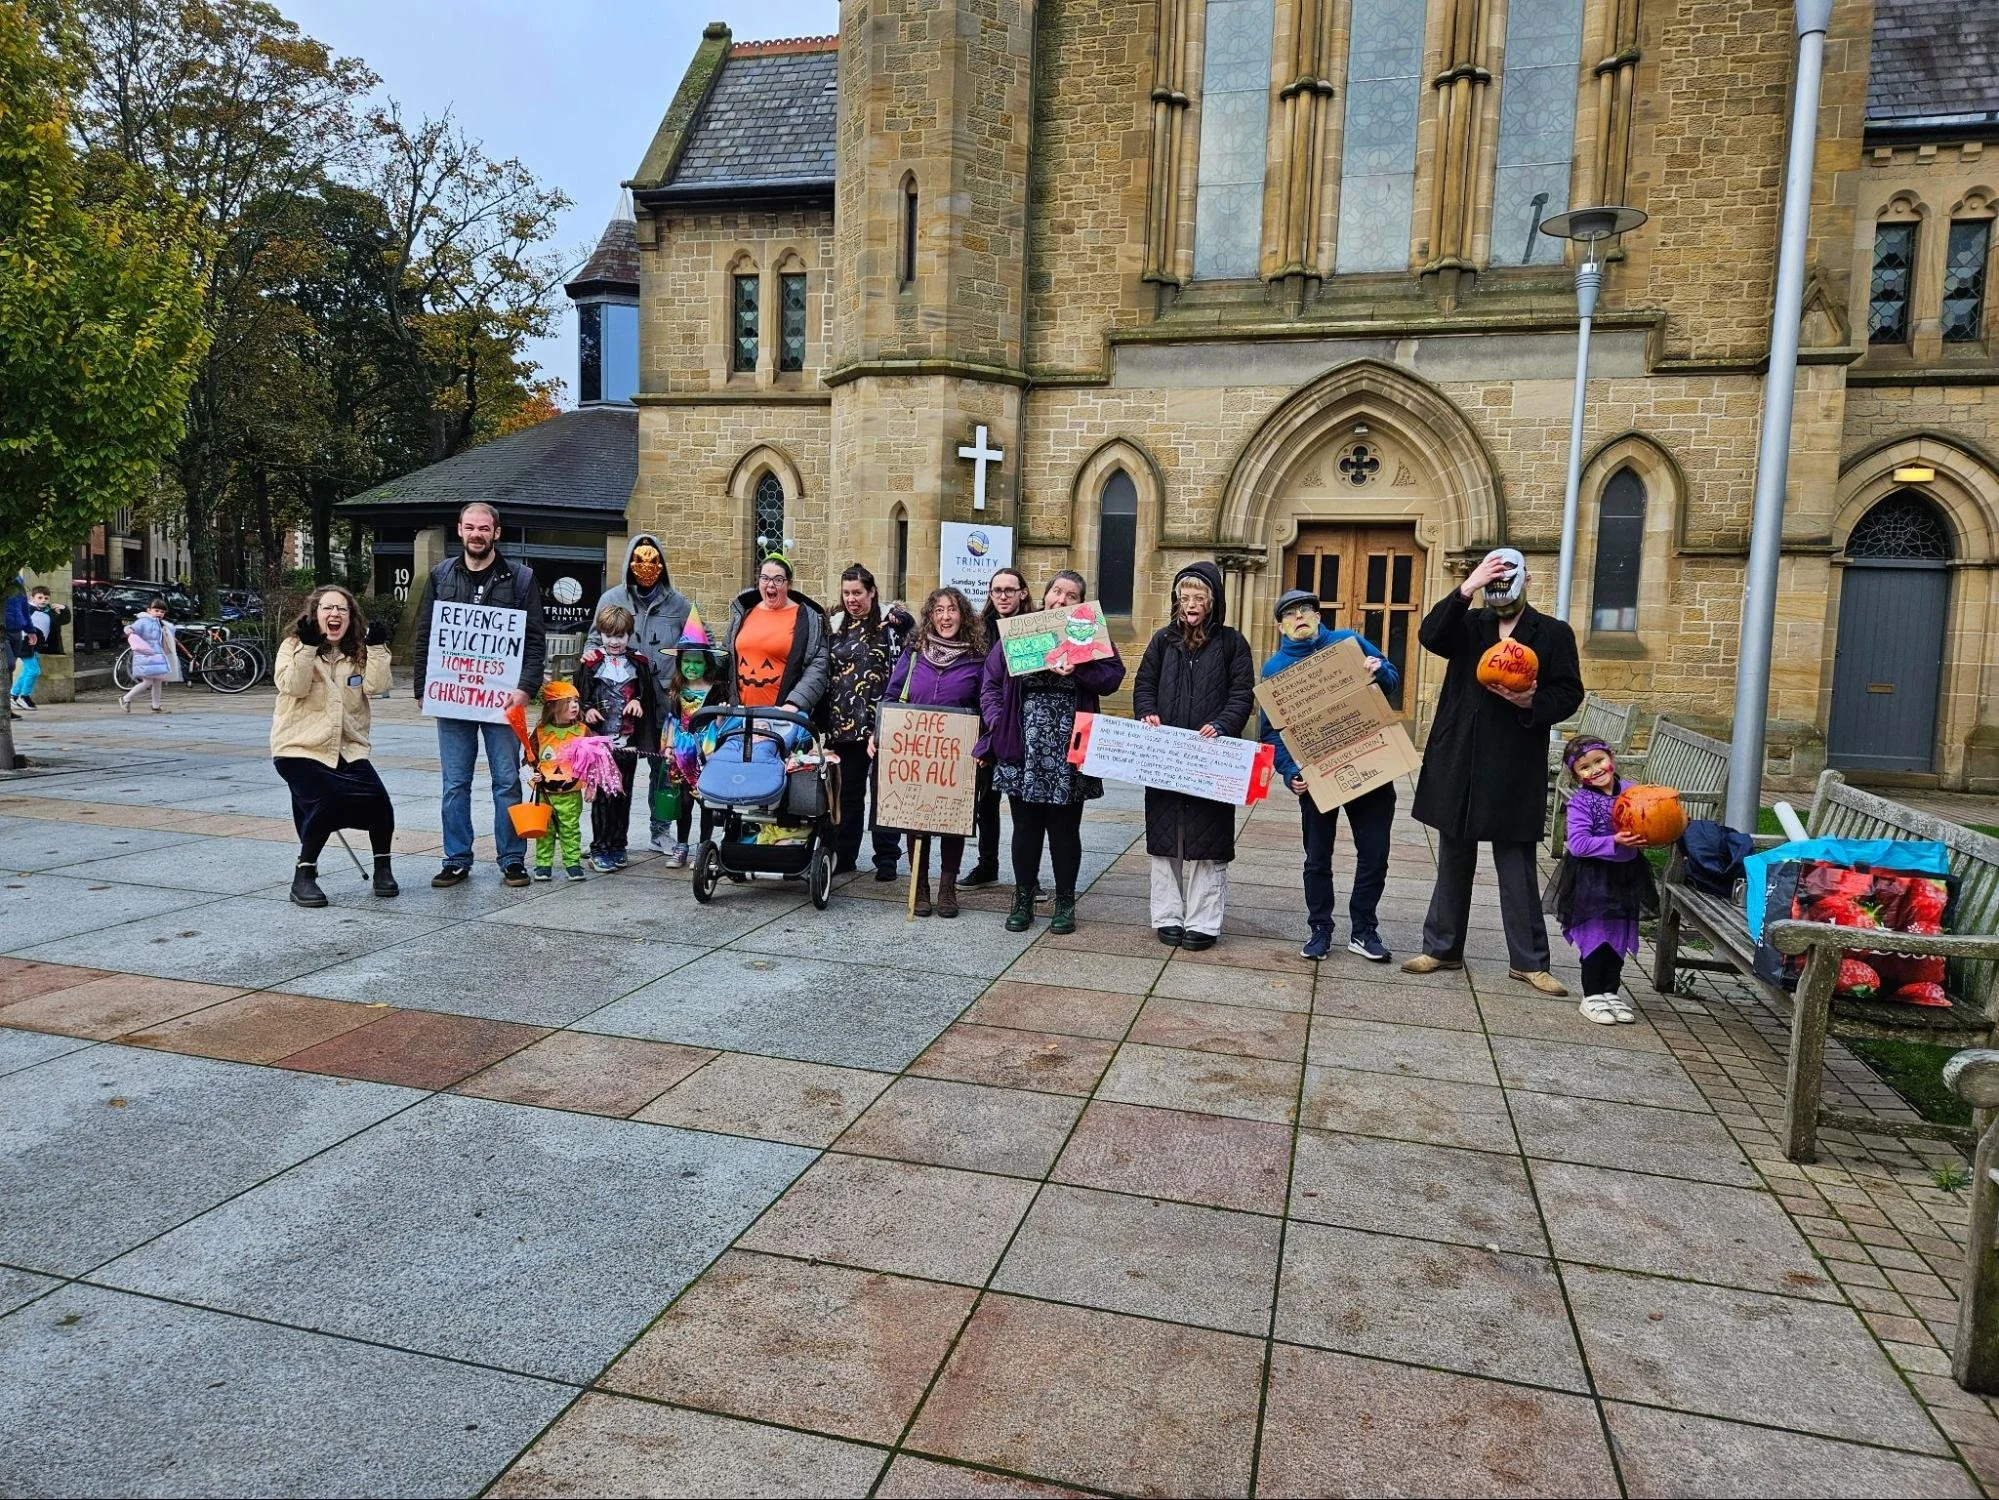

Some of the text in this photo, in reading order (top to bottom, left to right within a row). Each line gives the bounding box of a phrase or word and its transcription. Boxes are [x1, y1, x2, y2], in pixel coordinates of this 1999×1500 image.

[956, 557, 999, 568] TRINITY
[394, 568, 410, 585] 19
[951, 578, 976, 587] Sunday
[440, 606, 517, 632] REVENGE
[543, 606, 591, 616] TRINITY
[438, 628, 523, 657] EVICTION
[1502, 643, 1524, 659] NO
[441, 655, 505, 676] HOMELESS
[1270, 668, 1296, 684] FAMILY
[1321, 648, 1336, 657] RENT
[458, 673, 485, 685] FOR
[1276, 677, 1306, 694] LEAKING
[1281, 669, 1341, 702] ELECTRICAL FAULTS
[904, 711, 948, 733] SAFE
[1291, 707, 1313, 721] DAMP
[1296, 713, 1322, 730] SEWAGE
[891, 732, 961, 760] SHELTER
[1319, 751, 1352, 772] ENQUIRE
[888, 759, 957, 787] FOR ALL
